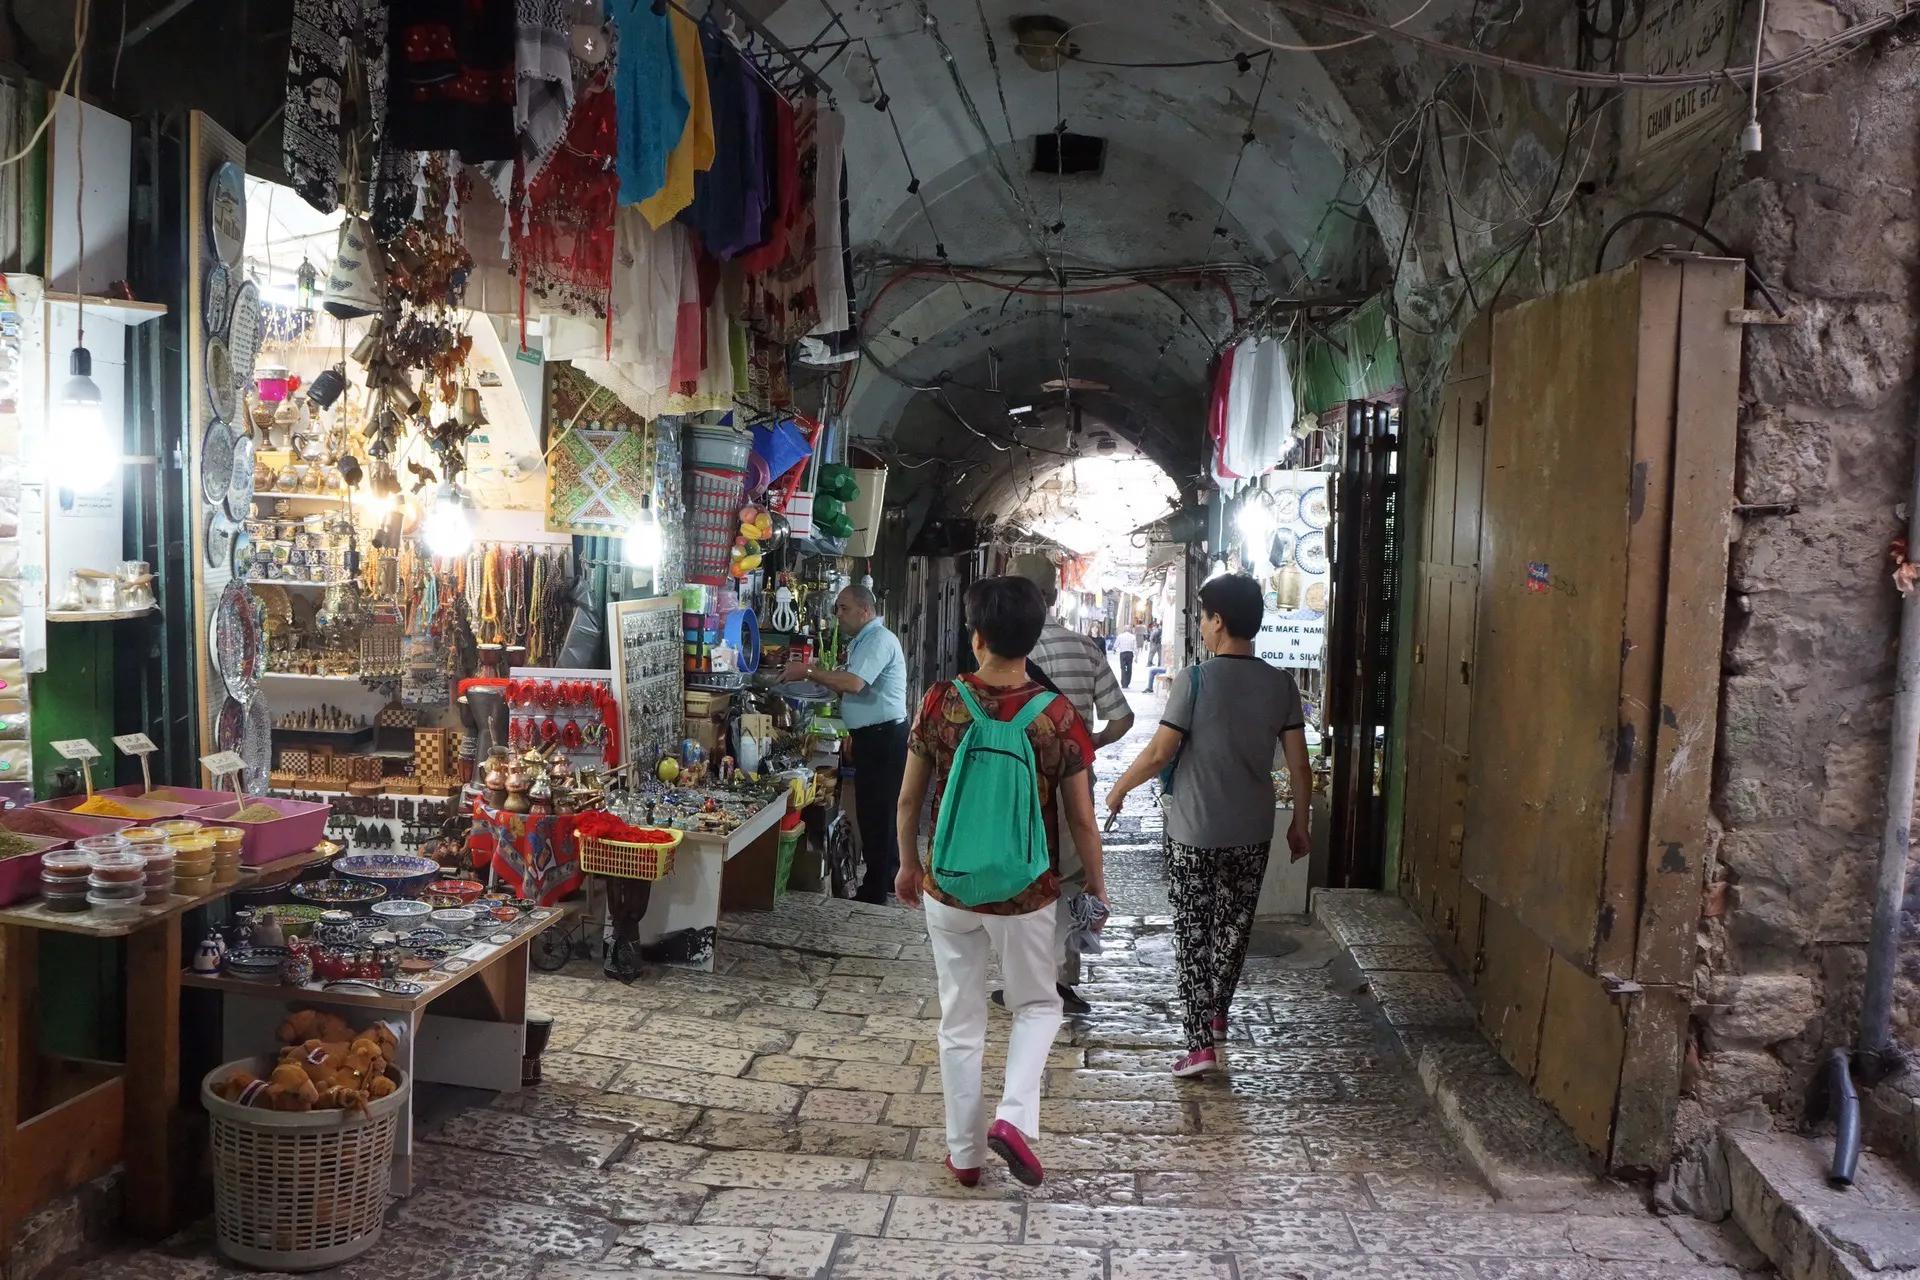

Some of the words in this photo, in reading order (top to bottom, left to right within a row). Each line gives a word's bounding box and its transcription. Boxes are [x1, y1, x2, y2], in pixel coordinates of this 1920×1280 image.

[1647, 102, 1672, 139] CHAIN
[1675, 87, 1697, 124] GATE
[1261, 625, 1274, 633] WE
[1275, 625, 1299, 633] MAKE
[1291, 638, 1300, 646] IN
[1261, 652, 1284, 660] GOLD
[1289, 653, 1295, 661] &
[1300, 653, 1321, 661] SILV
